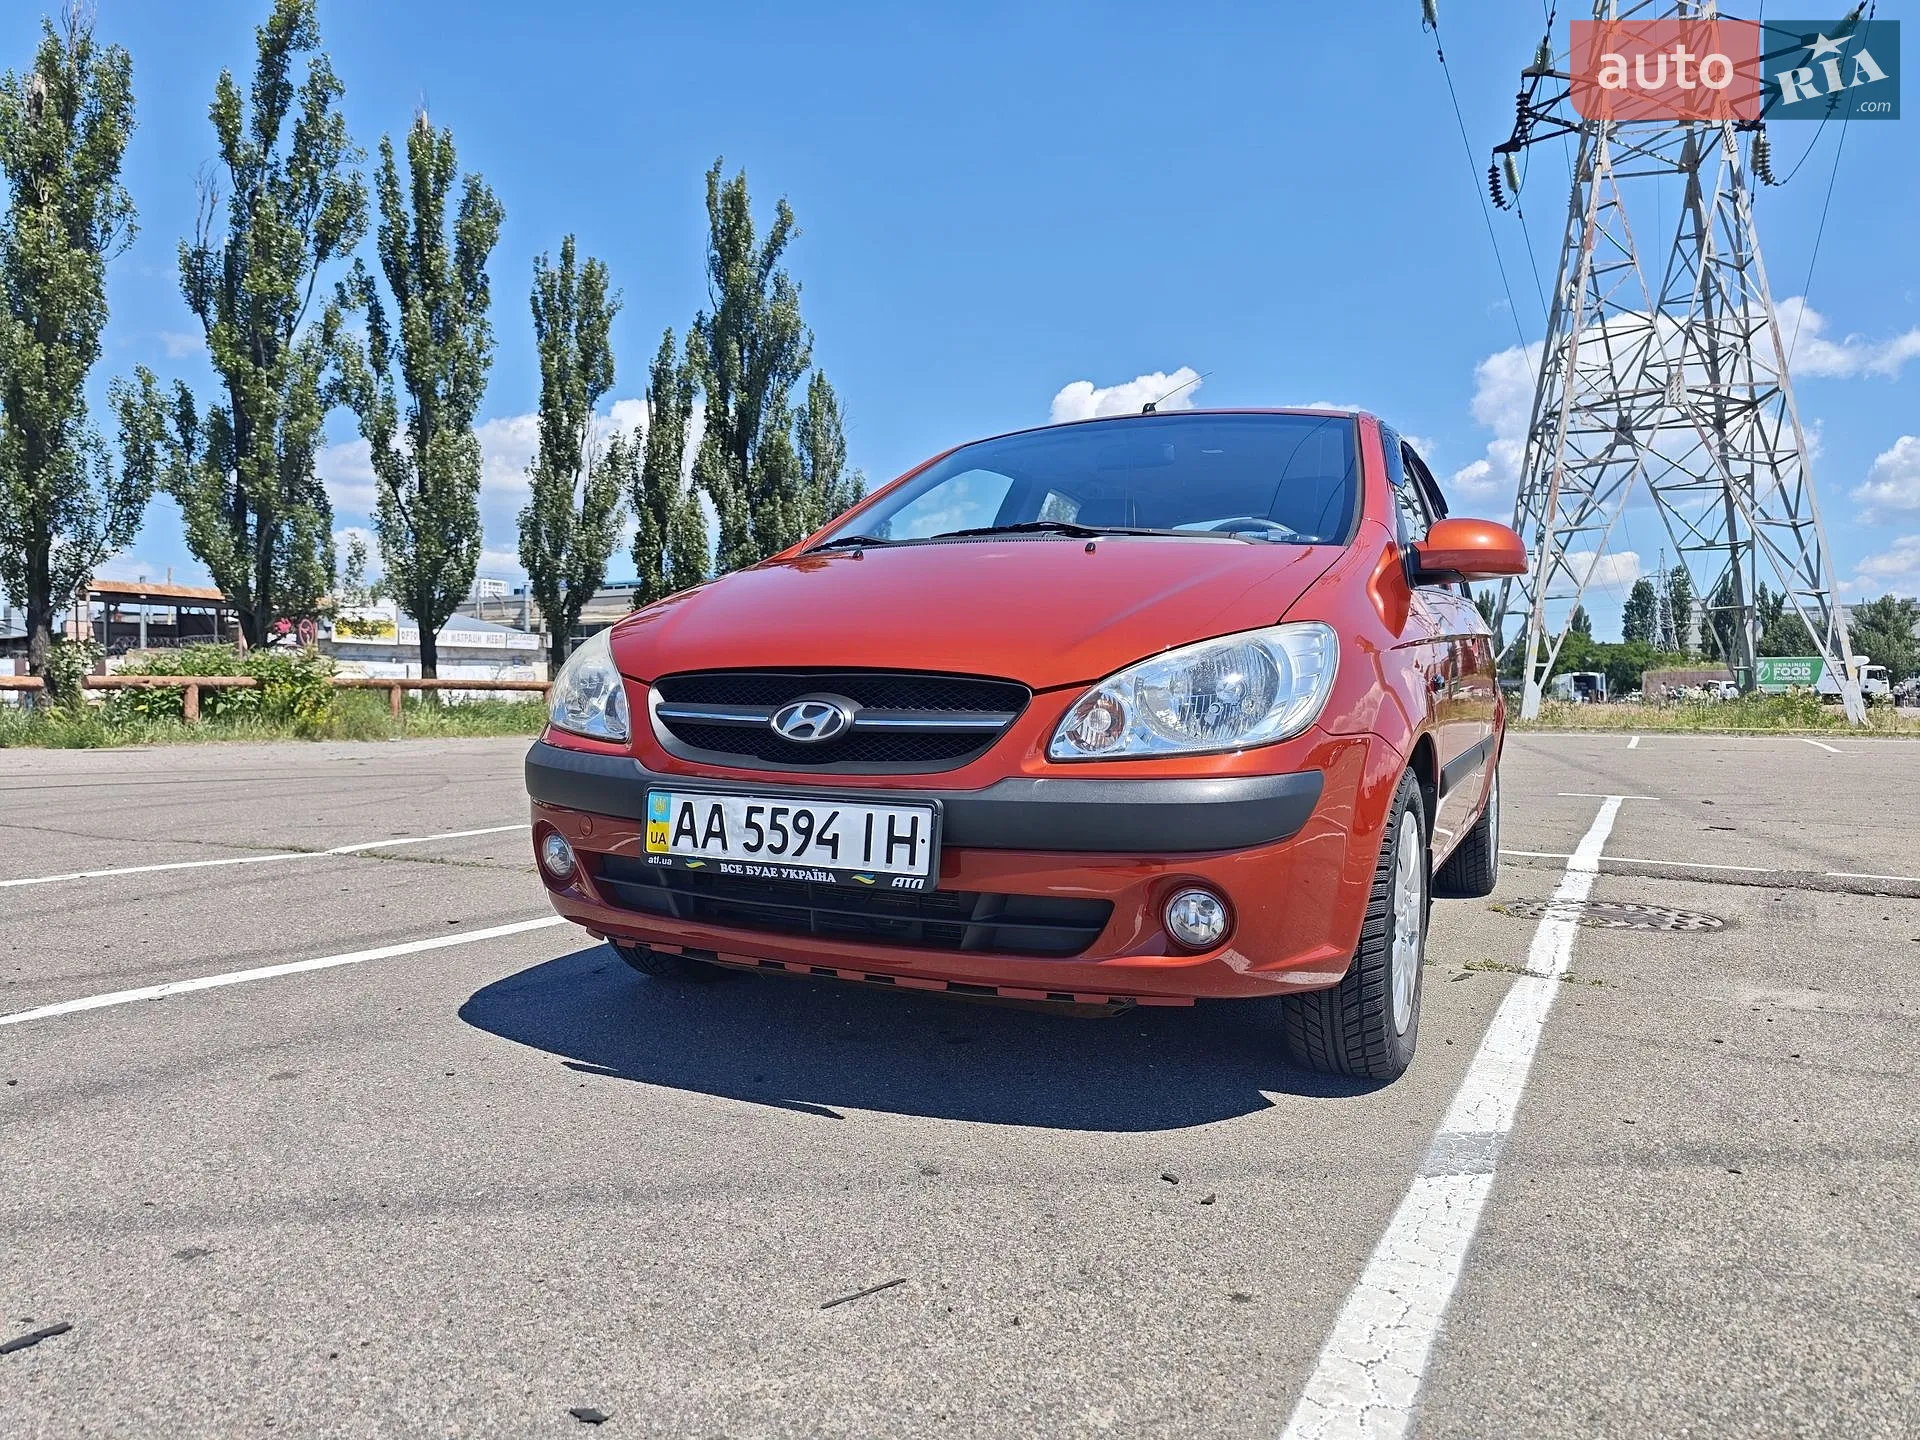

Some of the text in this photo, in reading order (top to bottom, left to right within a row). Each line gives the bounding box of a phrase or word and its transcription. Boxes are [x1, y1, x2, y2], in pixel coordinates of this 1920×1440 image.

[1774, 667, 1811, 677] FOOD
[650, 831, 667, 846] UA
[671, 801, 919, 867] AA 5594 IH
[647, 855, 673, 866] atl.ua
[719, 862, 837, 883] ВСЕ БУДЕ УКРАЇНА
